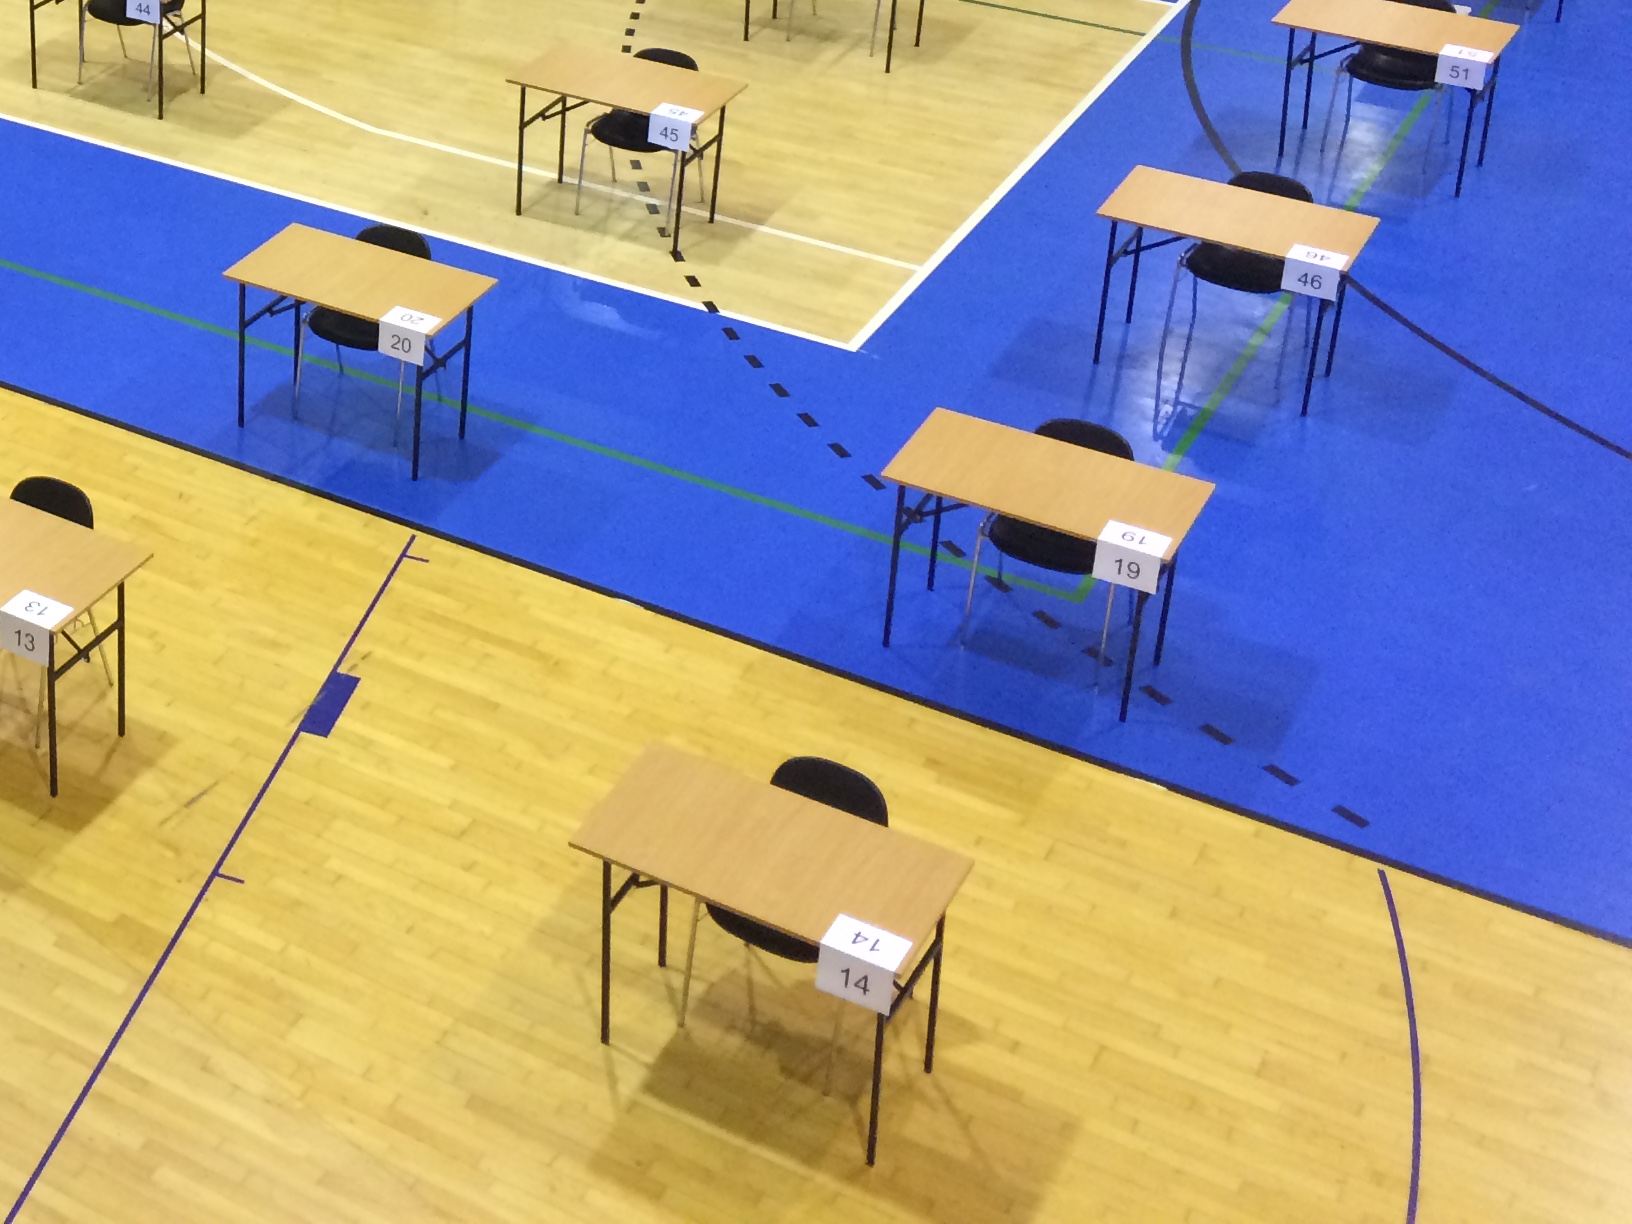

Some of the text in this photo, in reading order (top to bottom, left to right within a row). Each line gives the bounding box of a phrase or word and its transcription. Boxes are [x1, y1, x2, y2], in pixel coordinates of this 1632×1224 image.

[136, 3, 150, 15] 44
[1450, 66, 1469, 80] 51
[660, 127, 678, 141] 45
[1305, 252, 1330, 261] 46
[1298, 273, 1322, 289] 46
[401, 315, 424, 324] 20
[391, 335, 411, 353] 20
[1122, 532, 1145, 544] 19
[1115, 559, 1140, 579] 19
[25, 602, 48, 615] 13
[15, 630, 35, 651] 13
[852, 932, 879, 951] 14
[841, 968, 869, 995] 14
